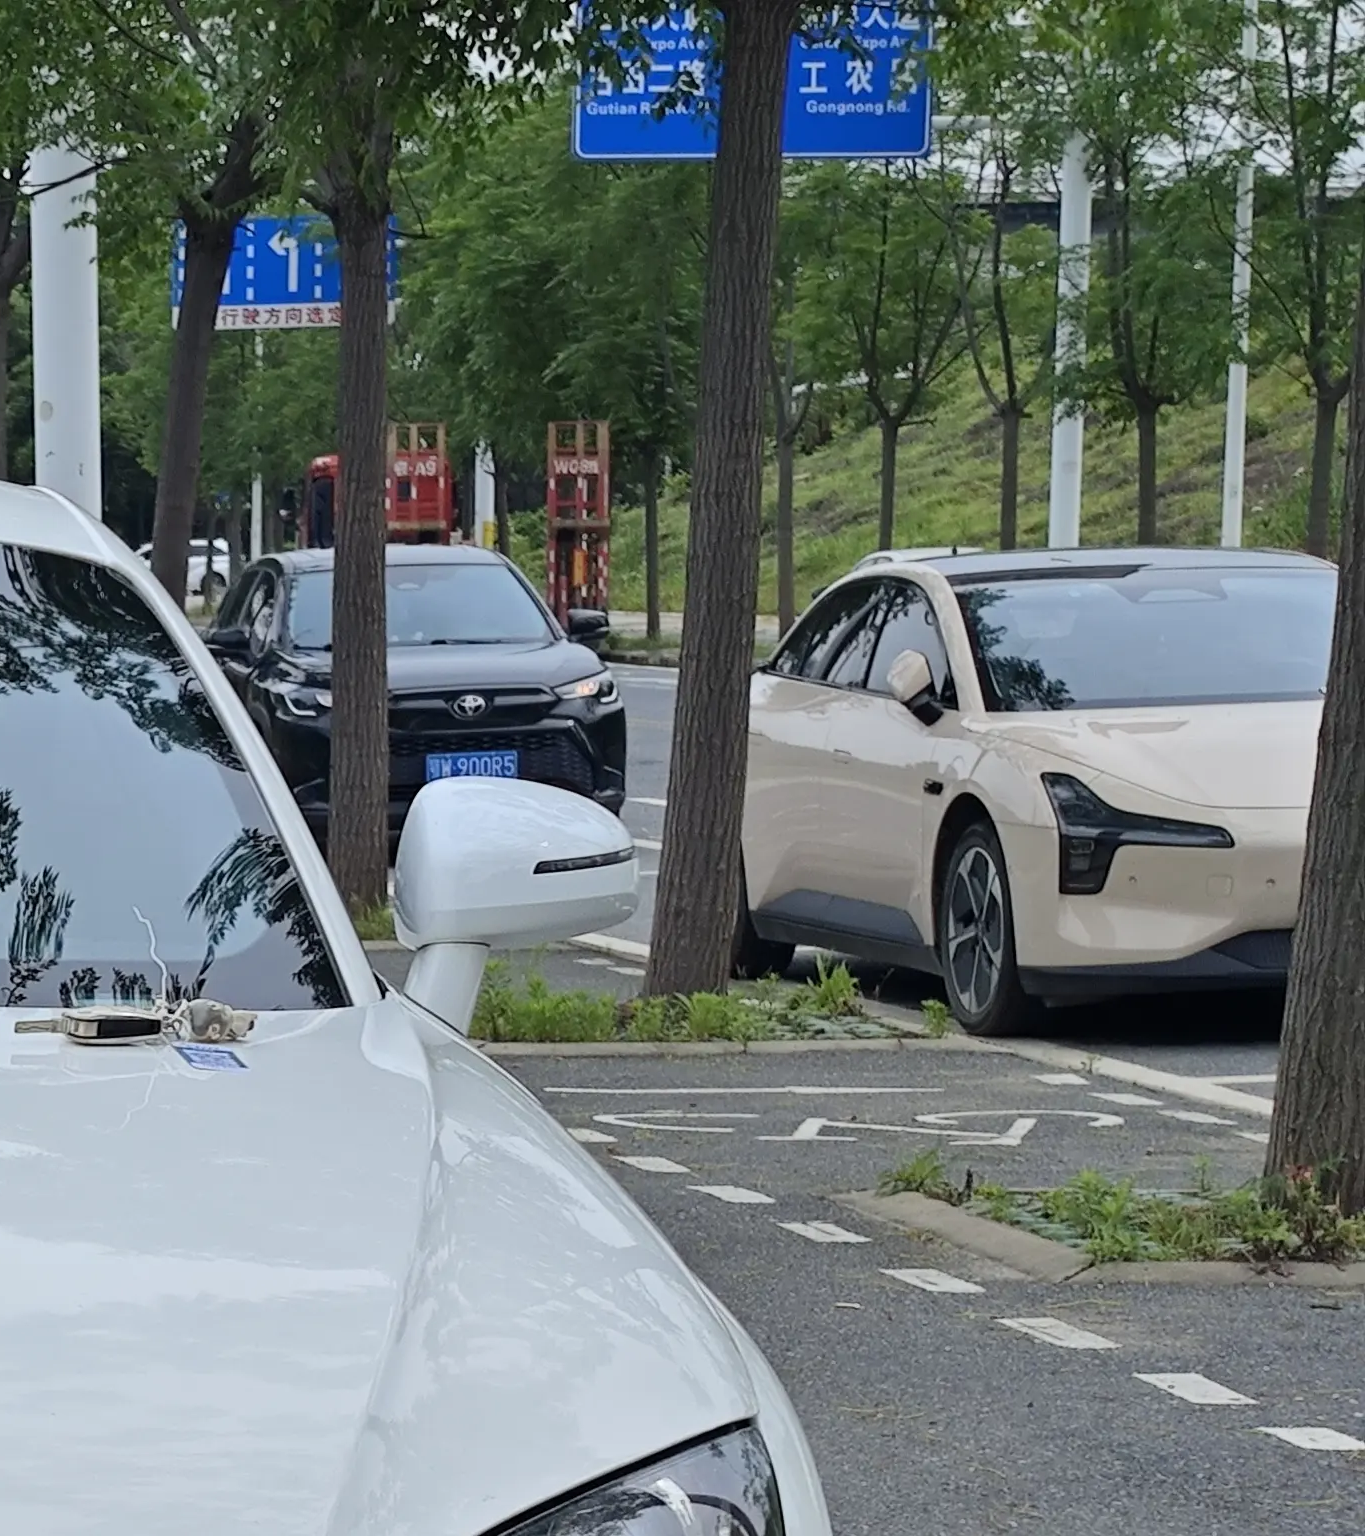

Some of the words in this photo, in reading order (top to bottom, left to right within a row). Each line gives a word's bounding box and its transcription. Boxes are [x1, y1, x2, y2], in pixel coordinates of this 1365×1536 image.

[646, 39, 677, 53] xpo
[586, 101, 637, 115] Gutian
[805, 100, 884, 116] Gongnong
